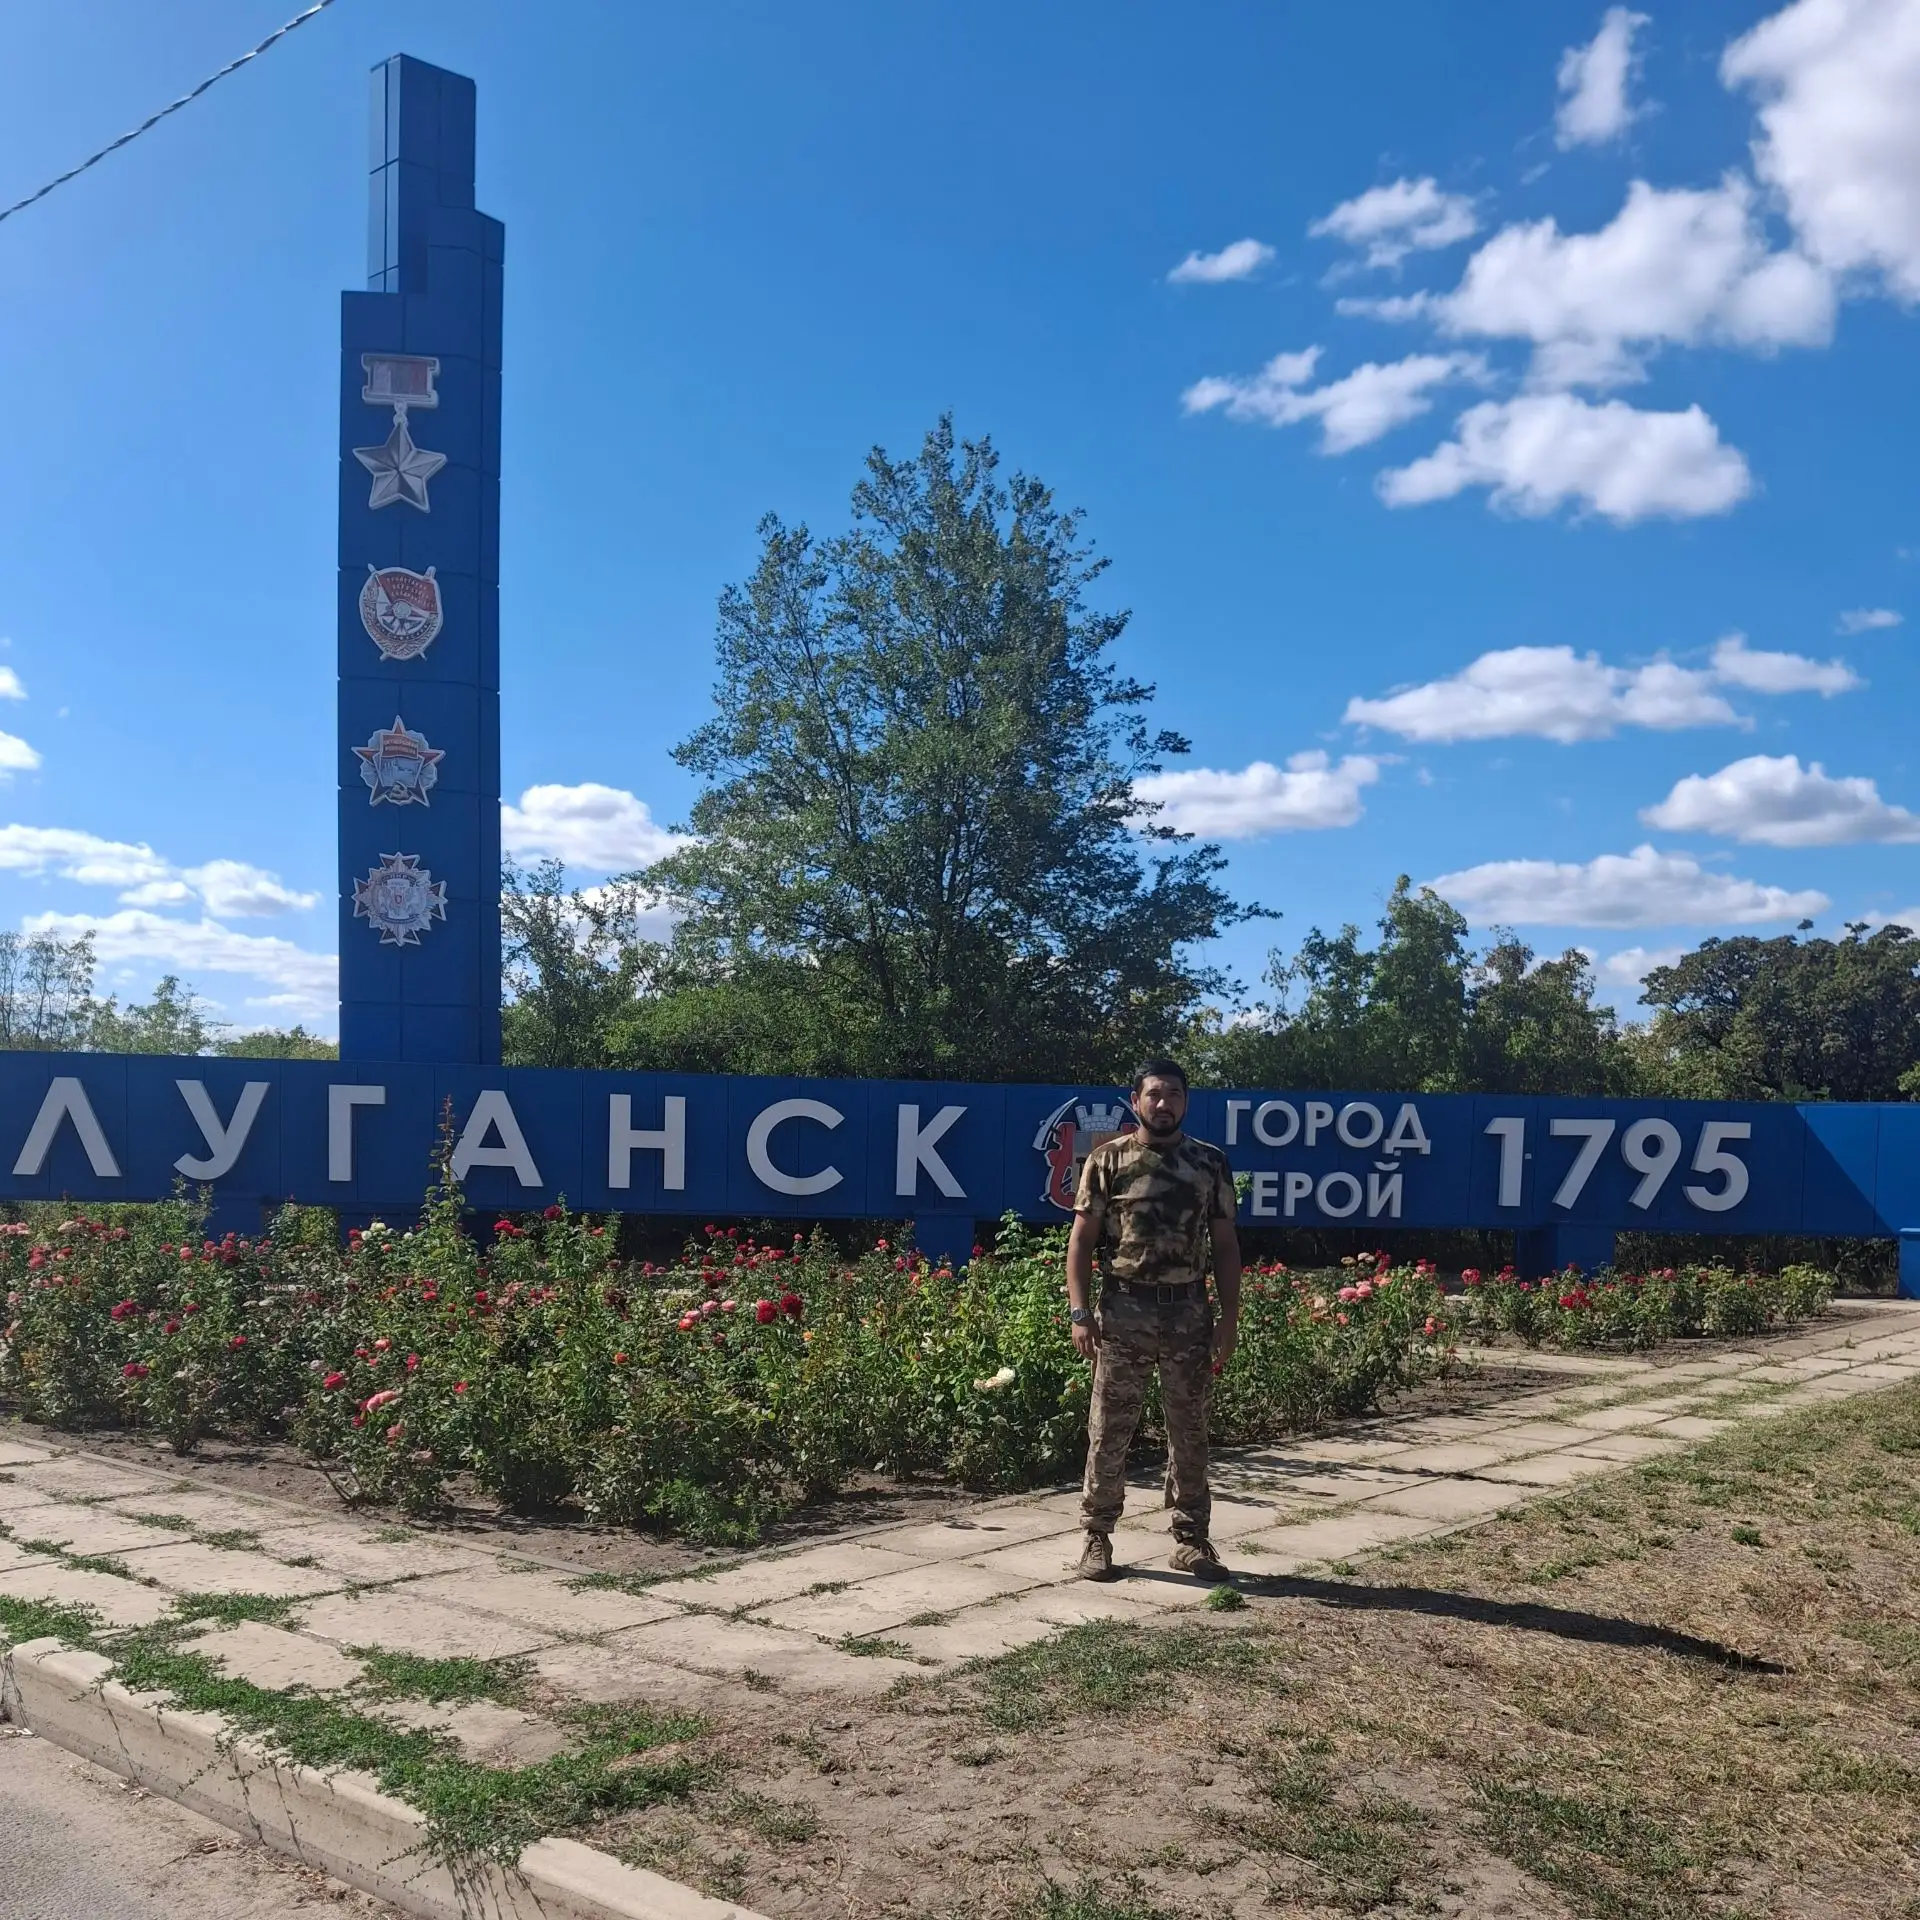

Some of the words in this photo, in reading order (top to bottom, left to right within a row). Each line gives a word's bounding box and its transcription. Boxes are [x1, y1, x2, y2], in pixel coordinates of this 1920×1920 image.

[12, 1076, 968, 1198] ЛУГАНСК
[1225, 1100, 1431, 1155] ГОРОД
[1484, 1116, 1752, 1212] 1795
[1231, 1161, 1403, 1218] ЕРОЙ
